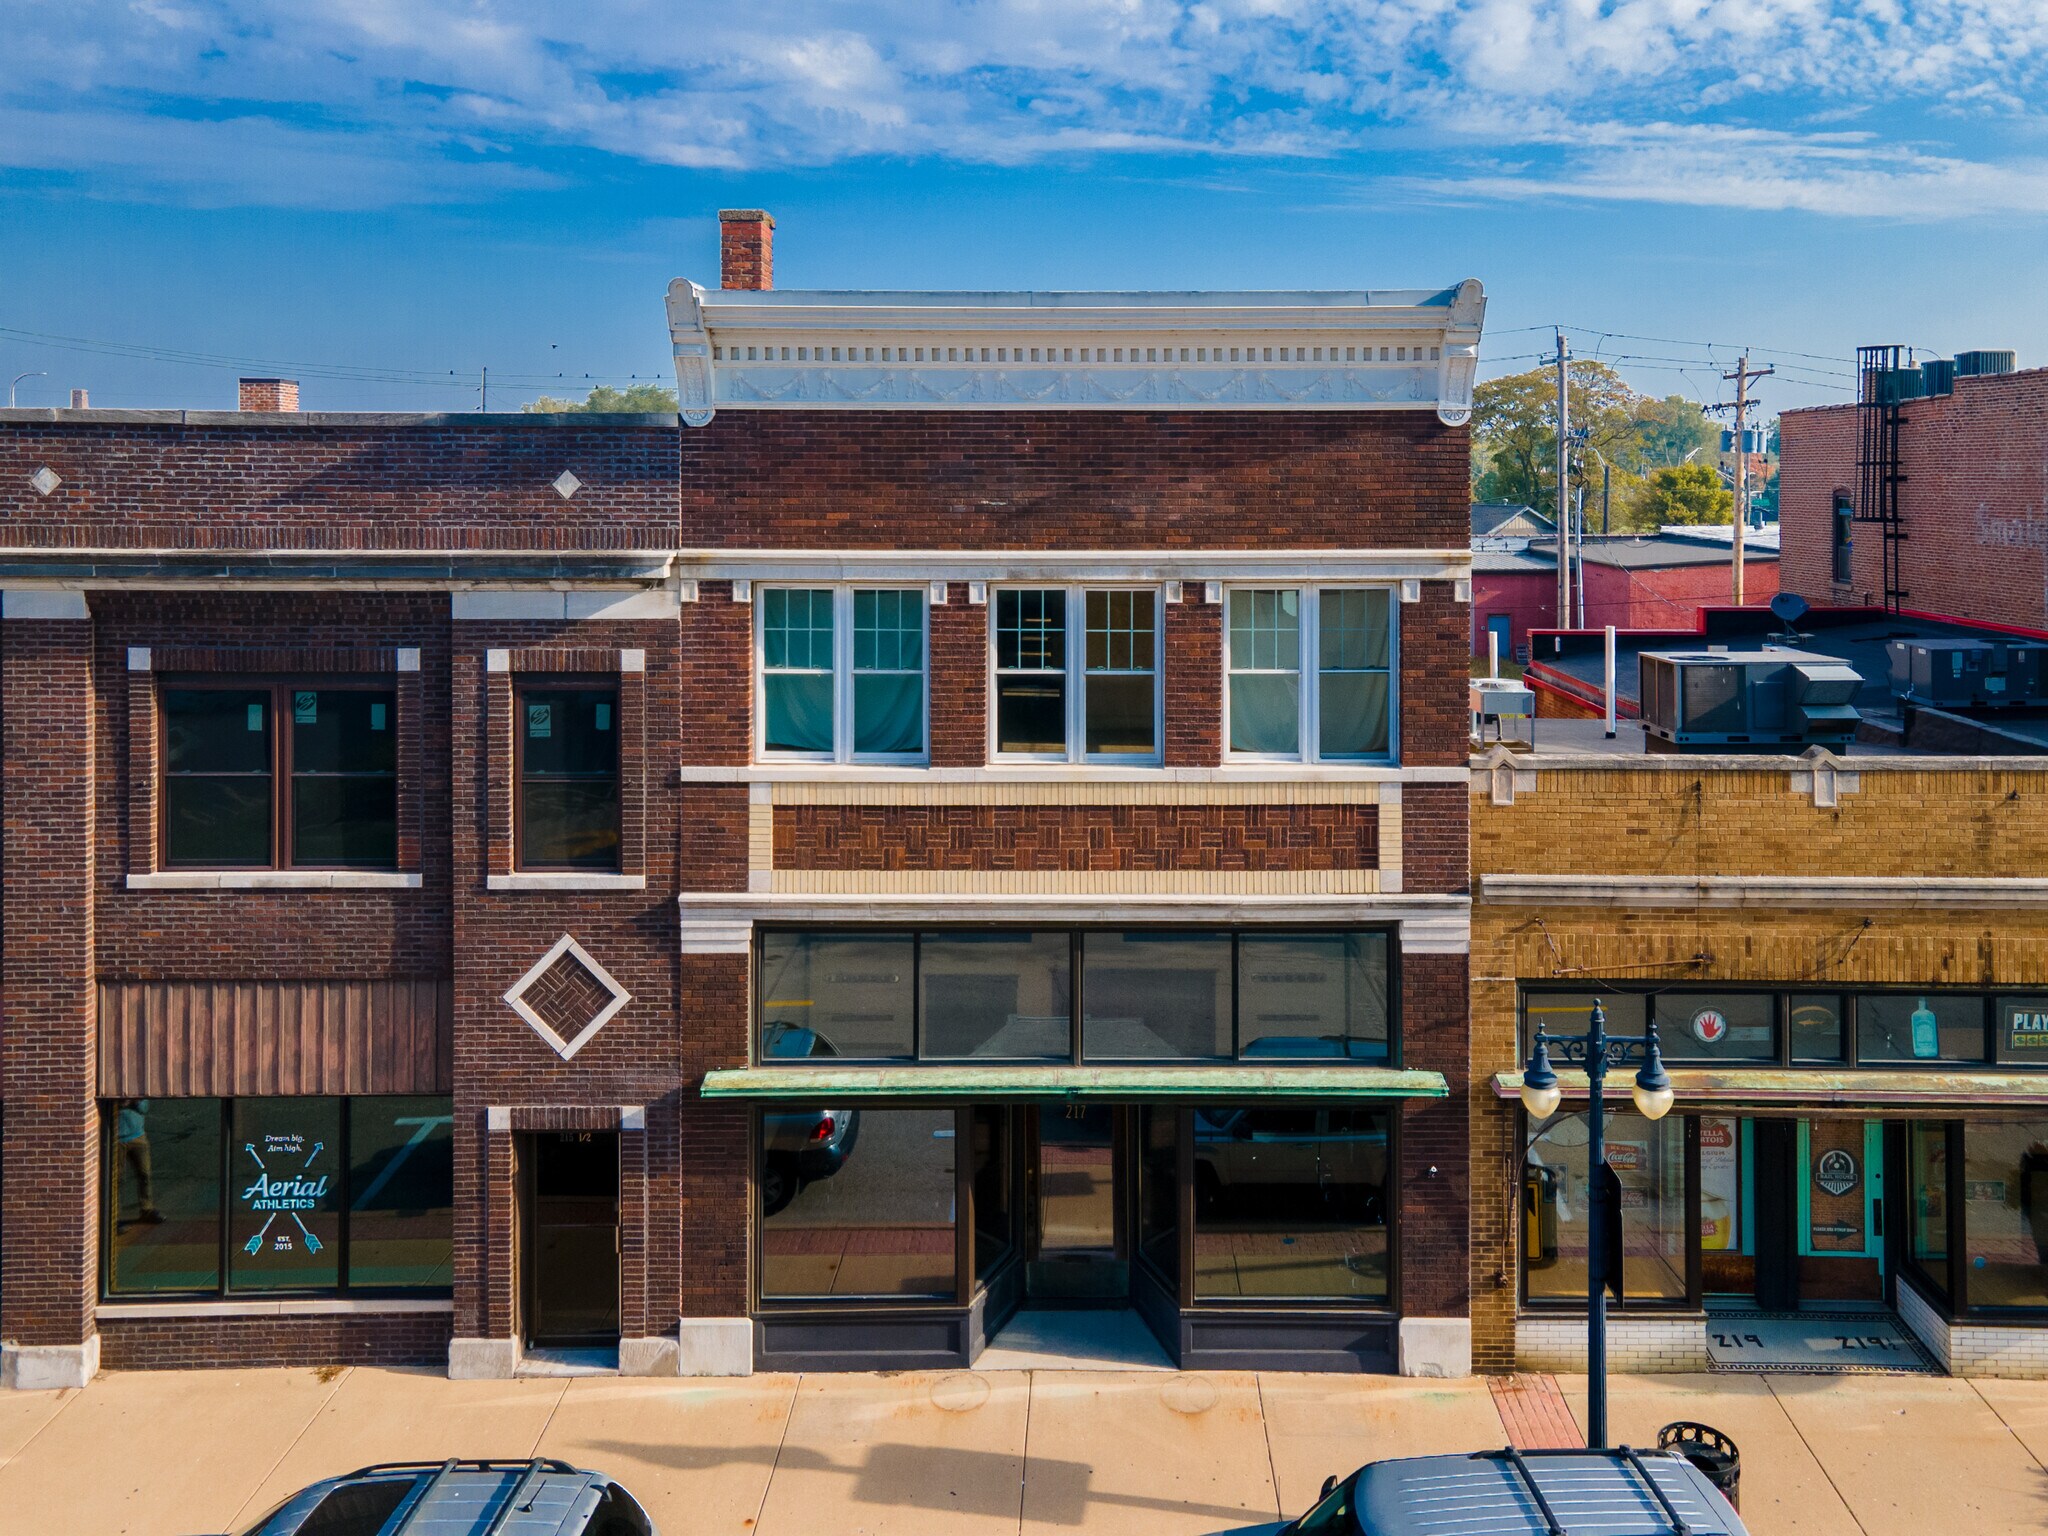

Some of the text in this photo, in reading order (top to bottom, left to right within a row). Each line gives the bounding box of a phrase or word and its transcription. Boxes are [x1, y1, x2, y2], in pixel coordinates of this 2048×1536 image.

[2013, 1013, 2048, 1030] PLAY
[1065, 1104, 1087, 1119] 217
[267, 1144, 283, 1152] Aim
[242, 1173, 328, 1199] Aerial
[252, 1199, 315, 1210] ATHLETICS
[1712, 1334, 1764, 1348] 219
